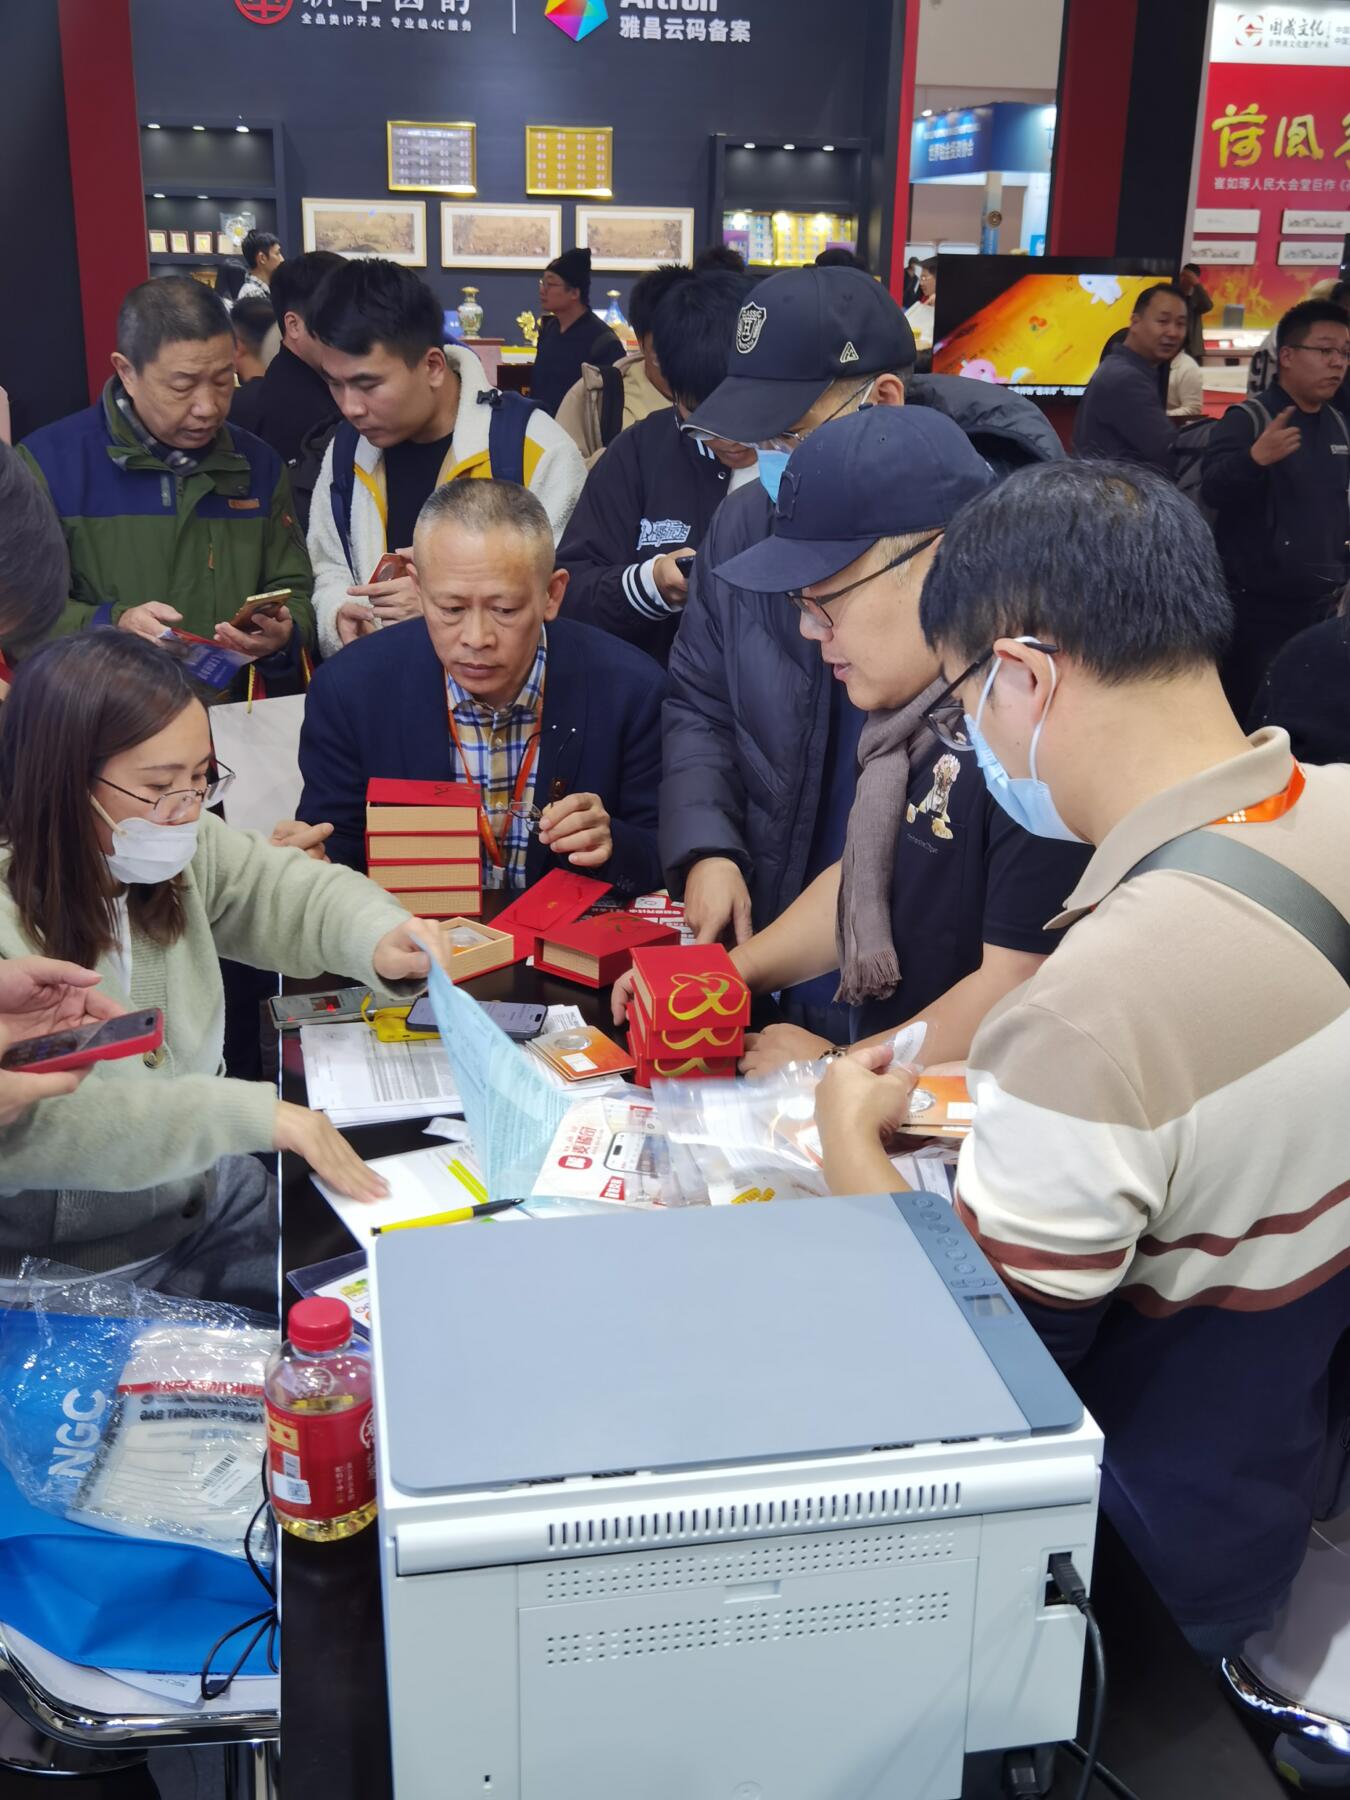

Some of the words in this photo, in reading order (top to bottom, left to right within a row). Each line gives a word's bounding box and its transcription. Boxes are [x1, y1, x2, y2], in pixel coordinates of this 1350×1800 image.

[301, 12, 381, 28] 全品类IP开发
[619, 15, 751, 42] 雅昌云码备案
[48, 1388, 106, 1478] NGC
